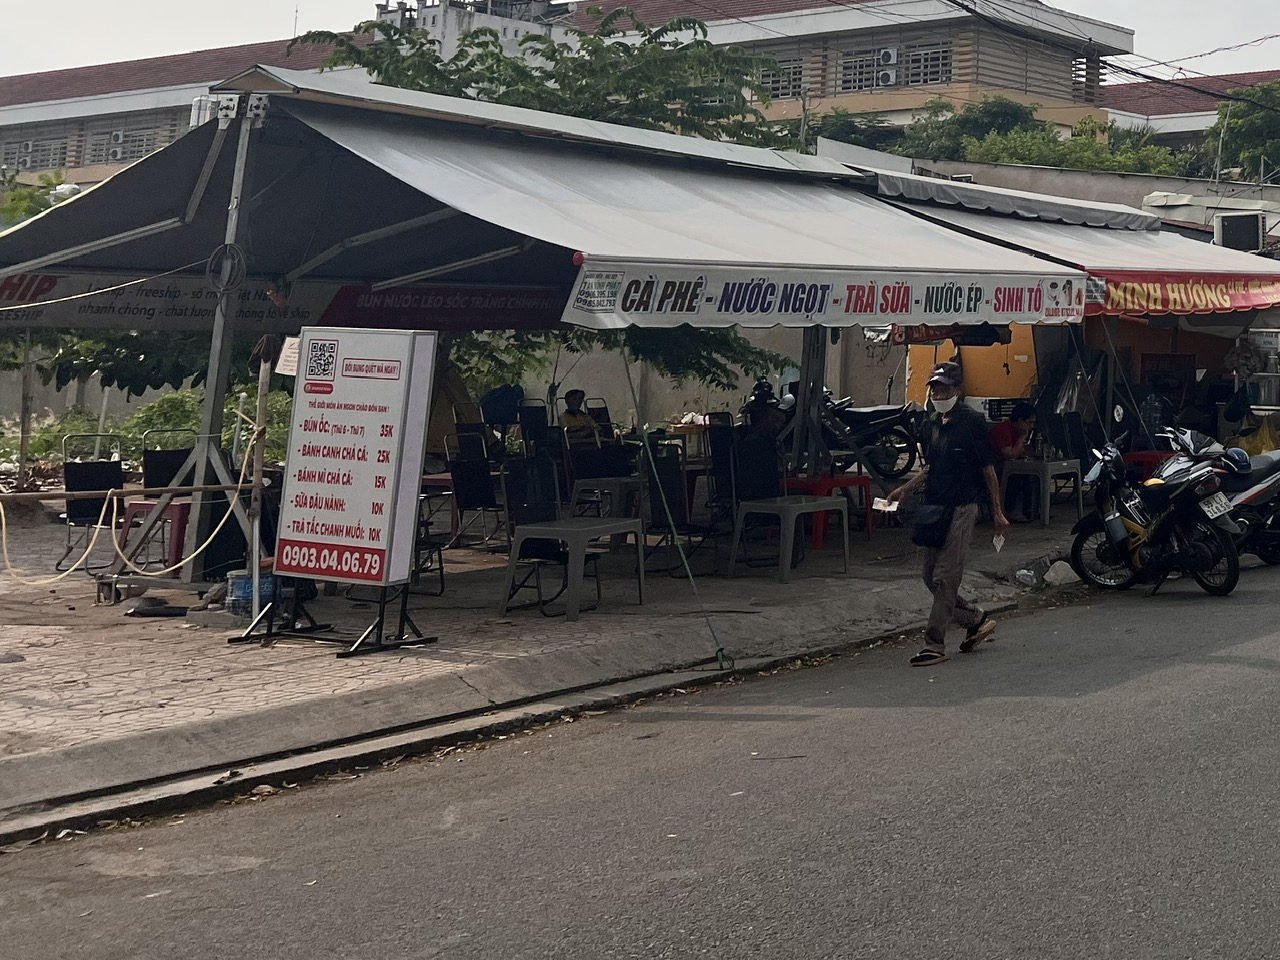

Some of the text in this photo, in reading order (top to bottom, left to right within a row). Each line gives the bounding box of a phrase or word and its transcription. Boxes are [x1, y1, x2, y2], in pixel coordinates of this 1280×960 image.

[621, 275, 656, 313] CÀ
[657, 276, 704, 313] PHÊ
[717, 278, 777, 313] NƯỚC
[778, 281, 830, 318] NGỌT
[844, 280, 875, 313] TRÀ
[880, 281, 911, 313] SỮA
[923, 282, 962, 313] NƯỚC
[966, 280, 982, 313] ÉP
[993, 286, 1024, 313] SINH
[1026, 279, 1043, 312] TỐ
[1106, 282, 1162, 310] MINH
[1166, 279, 1232, 310] HƯƠNG
[78, 302, 115, 315] nhanh
[118, 303, 155, 319] chóng
[190, 305, 215, 320] lượn
[326, 400, 336, 409] MÓN
[343, 402, 355, 410] NGON
[303, 416, 317, 433] BÚN
[318, 414, 330, 433] ỐC:
[380, 424, 394, 438] 35K
[302, 441, 390, 463] BÁNH CANH CHẢ CÁ: 25K
[297, 467, 387, 489] BÁNH MÌ CHẢ CÁ: 15K
[294, 492, 384, 515] SỮA ĐẬU NÀNH: 10K
[292, 516, 381, 542] TRÀ TẮC CHANH MUỐI: 10K
[282, 545, 380, 575] 0903.04.06.79
